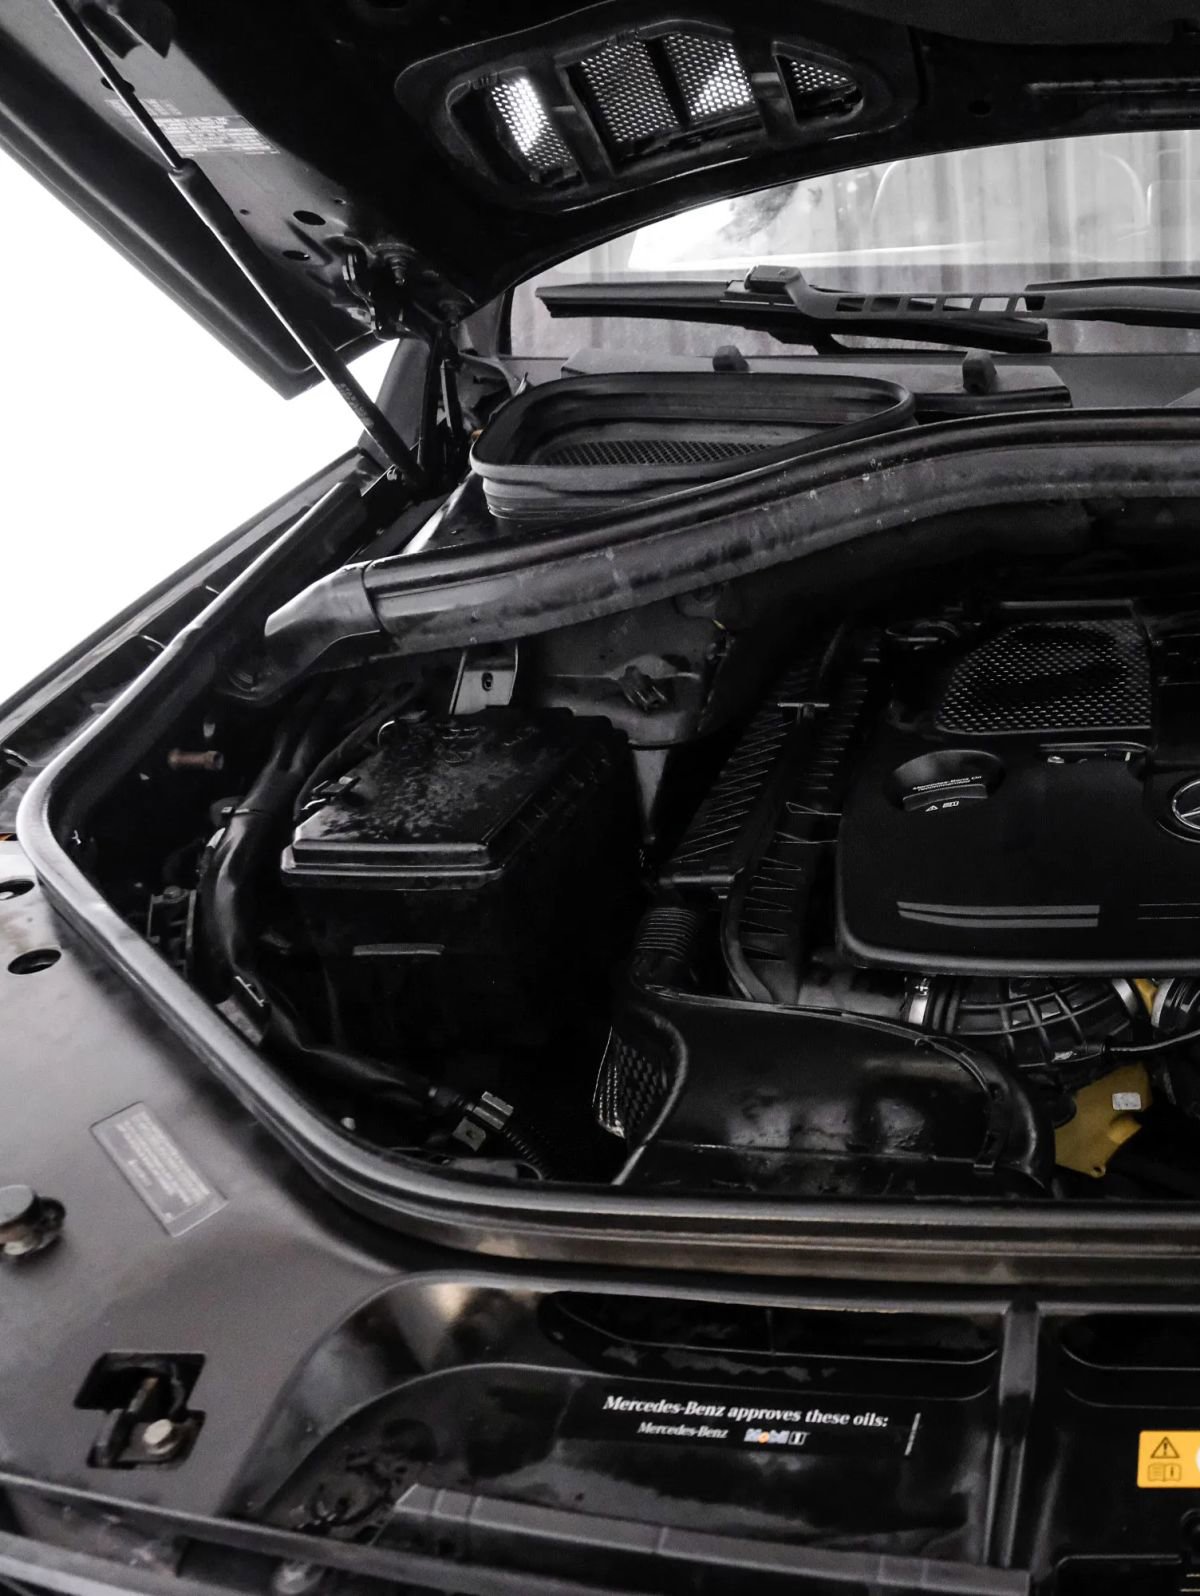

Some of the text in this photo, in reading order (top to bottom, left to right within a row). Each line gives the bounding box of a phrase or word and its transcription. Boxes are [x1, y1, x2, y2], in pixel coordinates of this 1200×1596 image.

[602, 1395, 889, 1428] Mercedes-Benz approves these oils:
[636, 1420, 729, 1440] Mercedes-Benz
